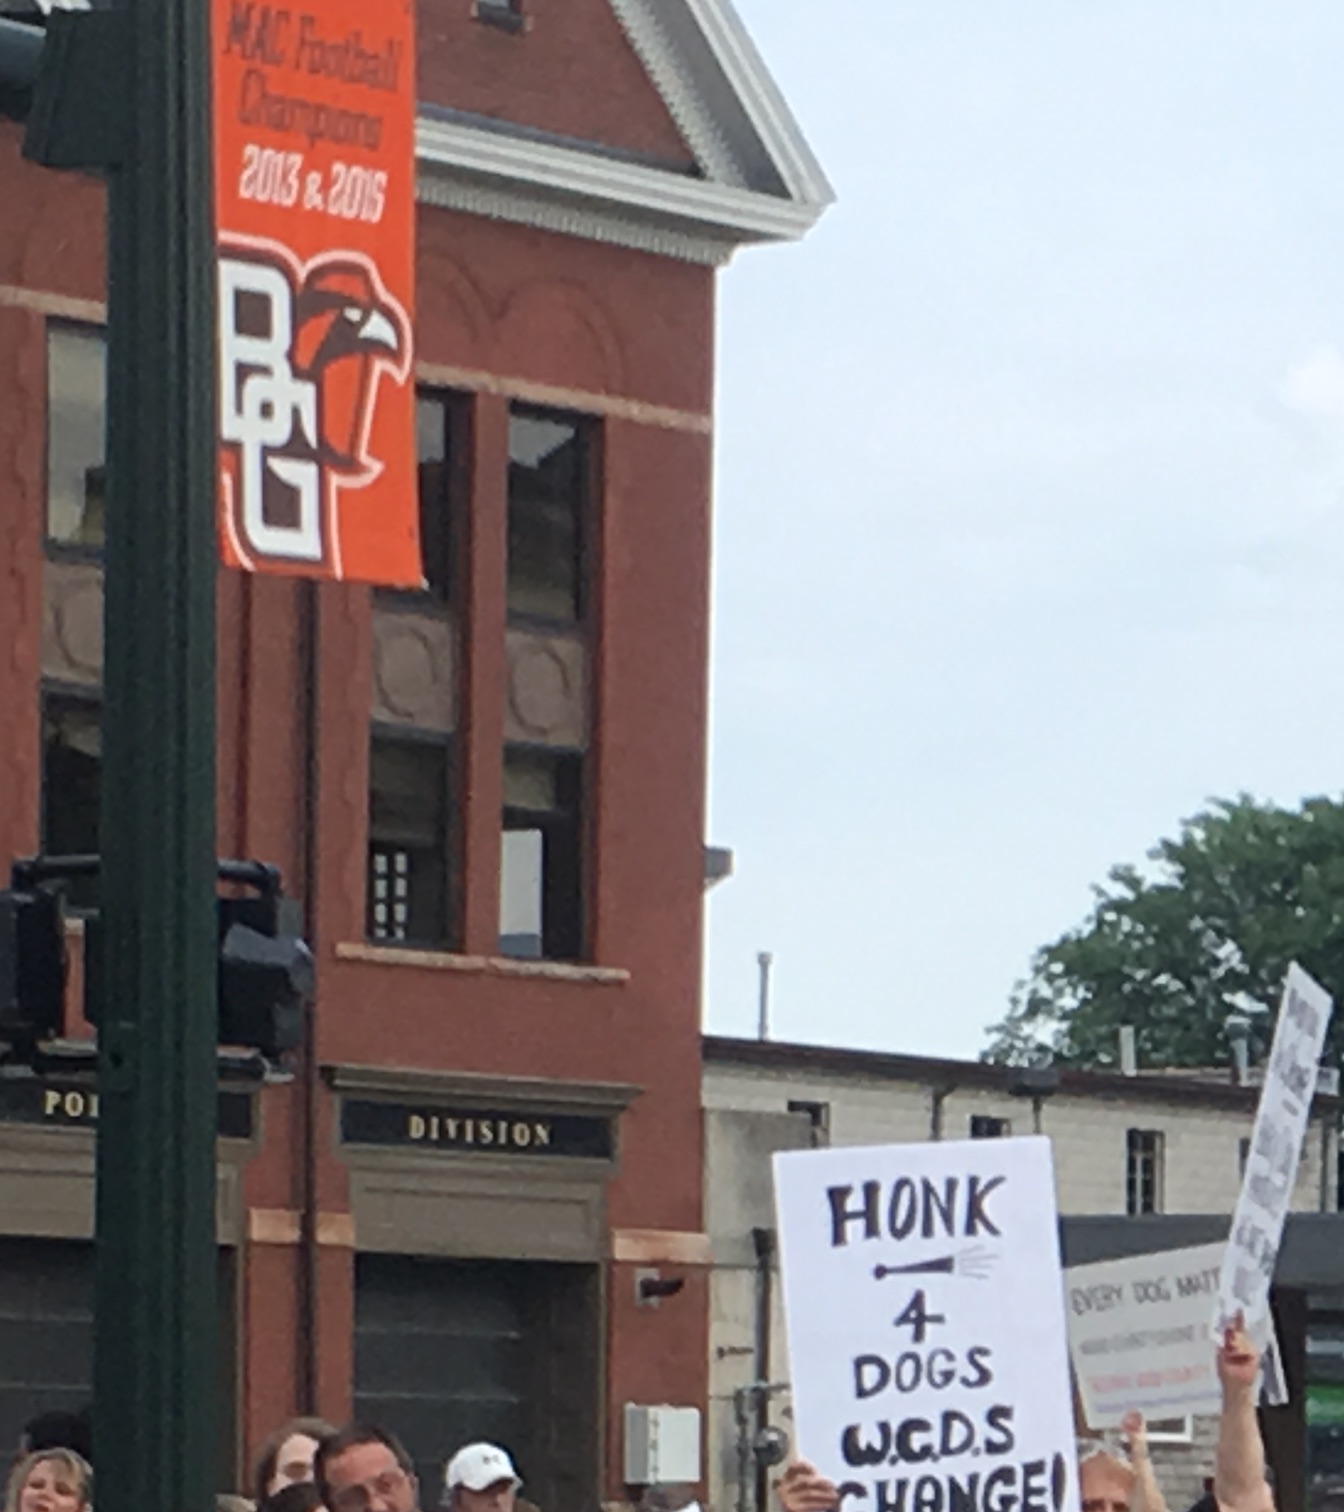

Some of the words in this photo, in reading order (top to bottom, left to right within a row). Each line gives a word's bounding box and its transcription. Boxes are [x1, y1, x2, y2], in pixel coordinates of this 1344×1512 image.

[294, 15, 402, 92] Football
[238, 69, 383, 153] Champions
[239, 143, 304, 207] 2013
[304, 171, 325, 211] &
[408, 1113, 551, 1147] DIVISION
[826, 1175, 1007, 1246] HONK
[893, 1288, 946, 1344] 4
[1070, 1283, 1123, 1316] EVERY
[1132, 1275, 1171, 1305] DOG
[1176, 1266, 1221, 1298] MATT
[852, 1346, 994, 1399] DOGS
